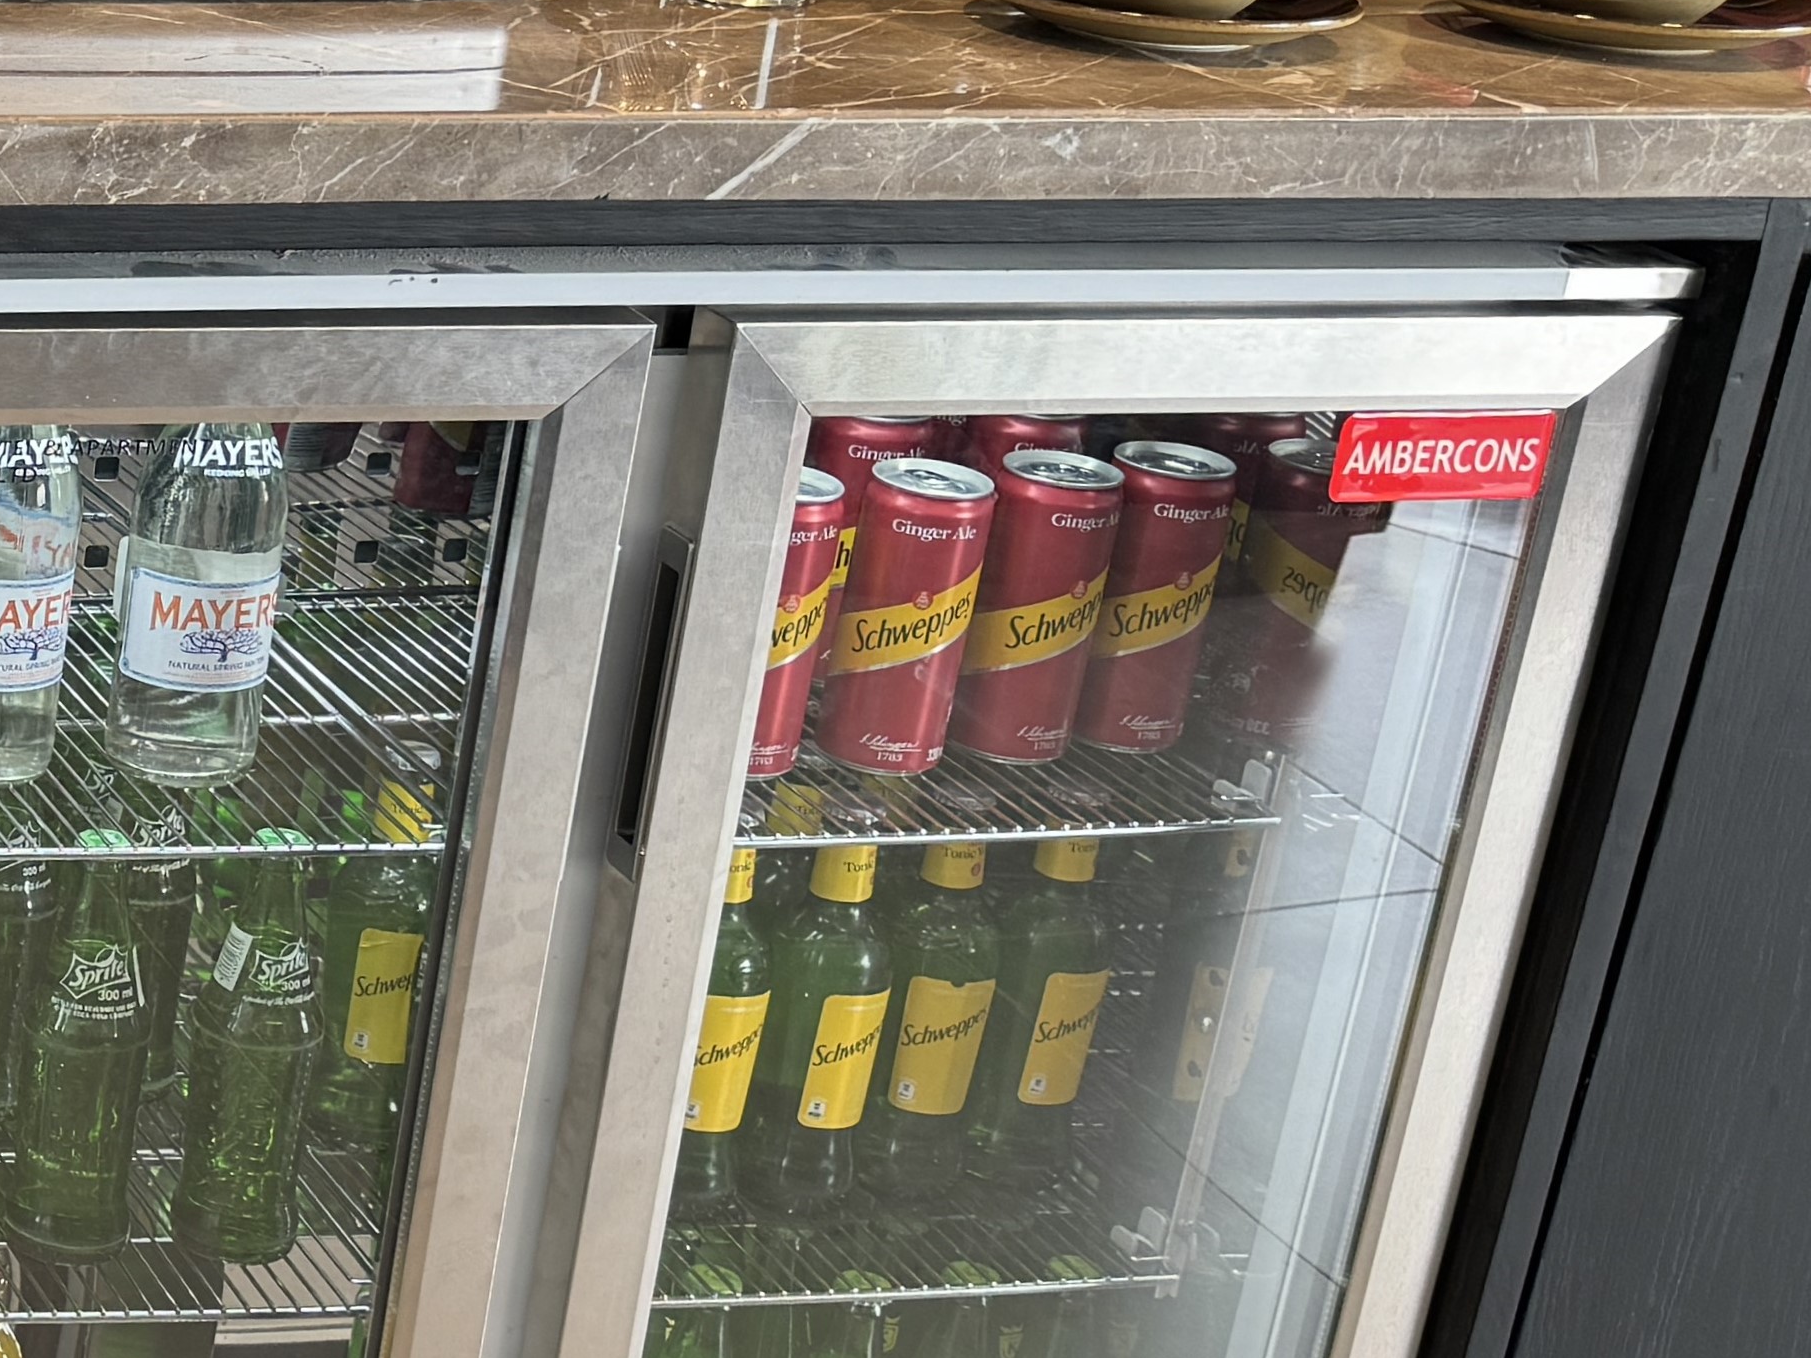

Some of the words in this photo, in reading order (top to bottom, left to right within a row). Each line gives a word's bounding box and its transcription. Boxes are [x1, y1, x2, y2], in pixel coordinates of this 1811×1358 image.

[173, 436, 284, 469] MAYERS
[1342, 436, 1540, 476] AMBERCONS
[1051, 511, 1107, 532] Ginger
[1153, 502, 1211, 523] Ginger
[818, 524, 839, 540] Ale
[892, 518, 951, 542] Ginger
[953, 525, 977, 540] Ale
[851, 590, 972, 654] Schweppes
[943, 846, 978, 860] Tonic
[729, 859, 753, 873] onic
[68, 955, 125, 990] Sprite
[97, 988, 121, 1002] 300
[281, 979, 301, 992] 300
